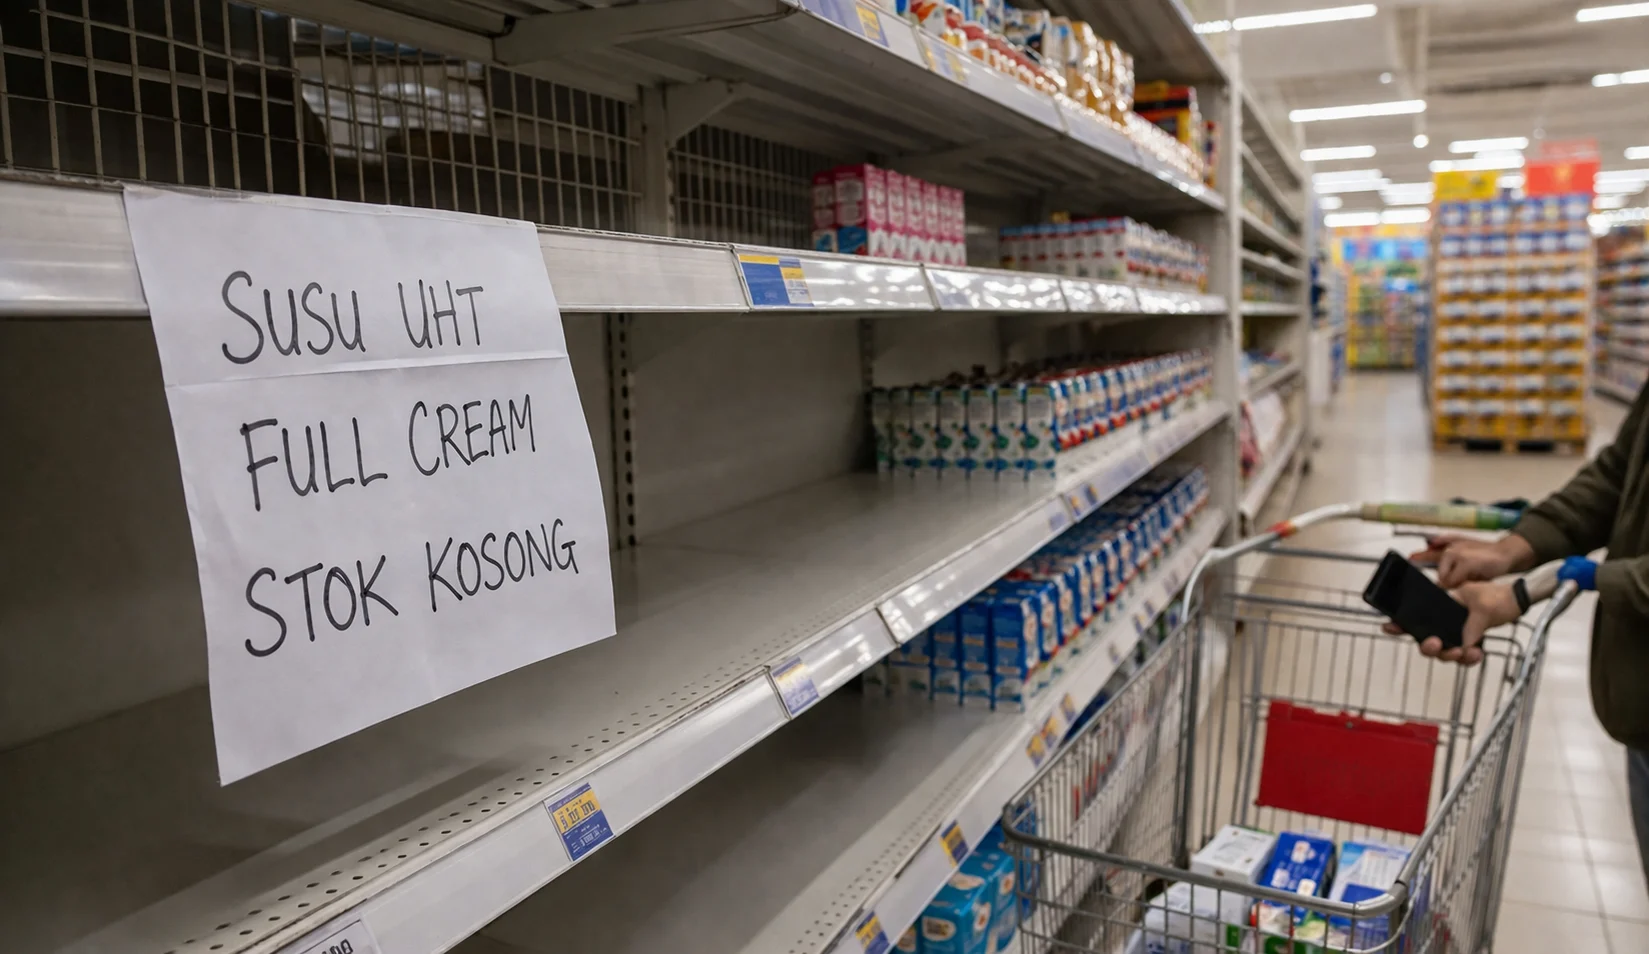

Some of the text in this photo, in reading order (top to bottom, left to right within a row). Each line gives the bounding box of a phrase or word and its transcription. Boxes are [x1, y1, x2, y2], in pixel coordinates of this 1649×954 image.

[221, 270, 484, 365] SUSU UHT
[239, 393, 536, 512] FULL CREAM
[244, 518, 579, 658] STOK KOSONG
